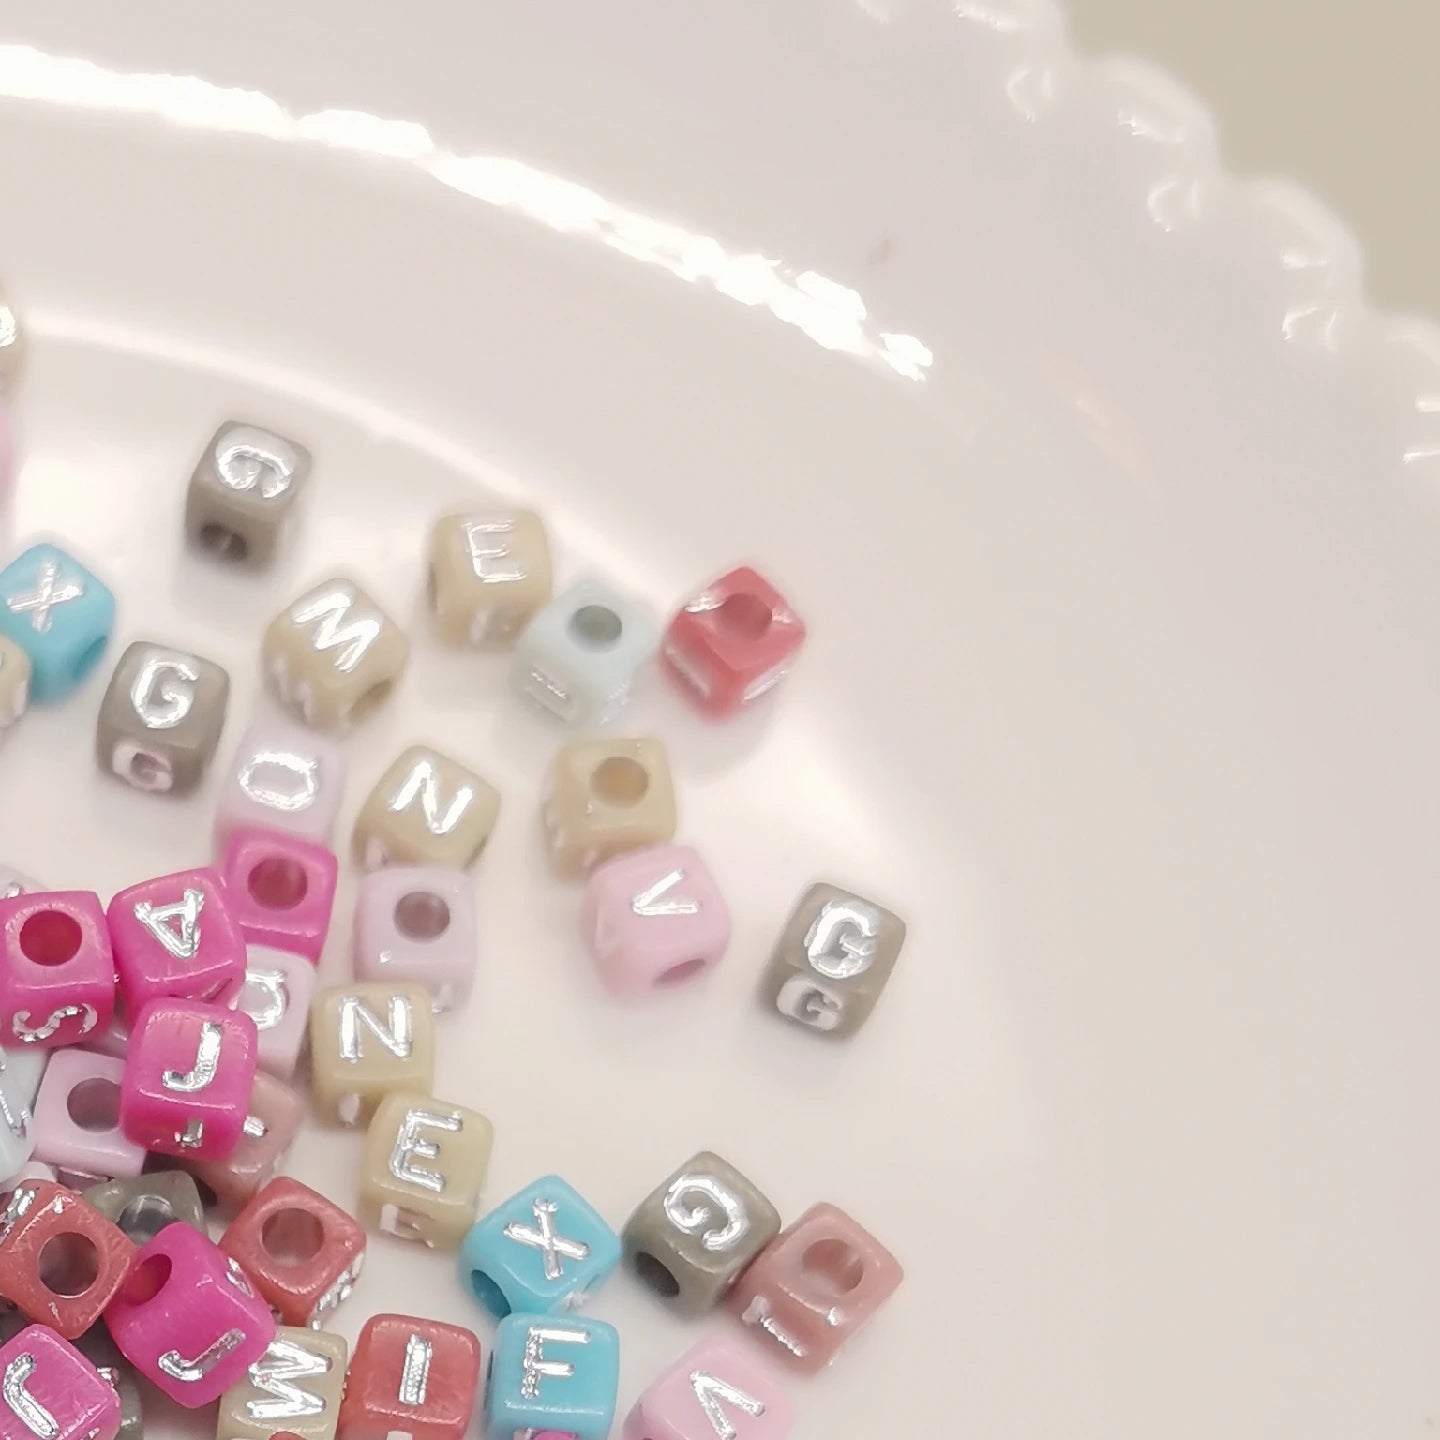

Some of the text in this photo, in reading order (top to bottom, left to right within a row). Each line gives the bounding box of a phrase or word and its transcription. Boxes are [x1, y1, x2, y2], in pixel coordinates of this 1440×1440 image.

[216, 427, 294, 500] G
[464, 519, 526, 583] E
[7, 558, 84, 632] X
[129, 654, 199, 729] G
[389, 759, 474, 834] N
[133, 889, 205, 959] A
[633, 868, 699, 916] V
[804, 901, 878, 979] G
[12, 1003, 98, 1043] S
[162, 1022, 223, 1092] J
[339, 996, 413, 1063] N
[389, 1109, 463, 1192] E
[504, 1198, 590, 1280] X
[665, 1174, 751, 1251] G
[158, 1328, 246, 1382] J
[398, 1333, 432, 1406] I
[520, 1326, 592, 1400] F
[3, 1352, 59, 1440] J
